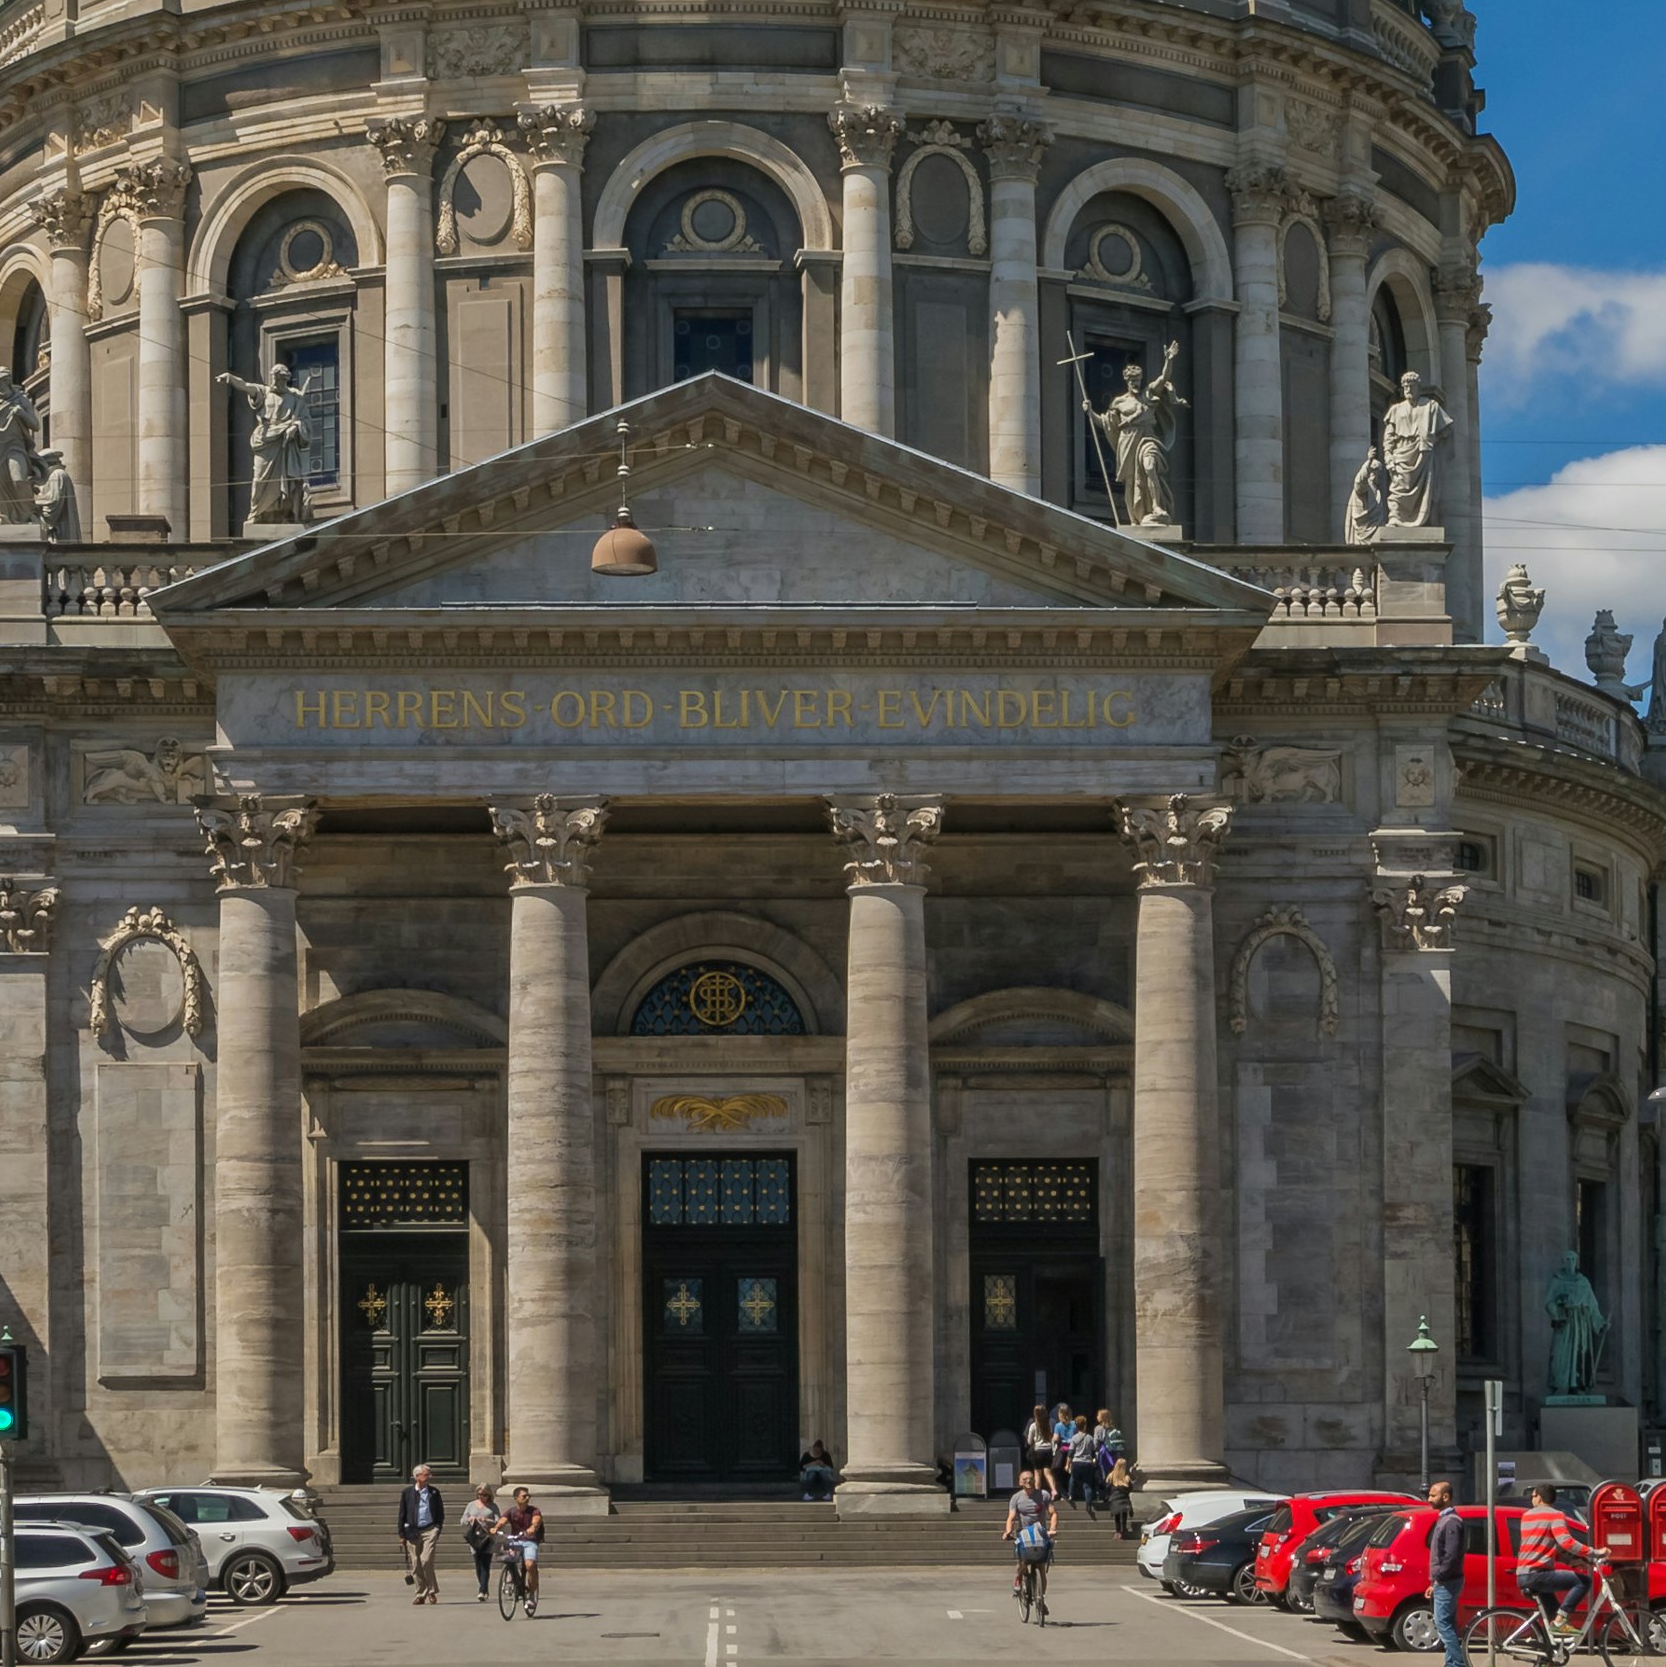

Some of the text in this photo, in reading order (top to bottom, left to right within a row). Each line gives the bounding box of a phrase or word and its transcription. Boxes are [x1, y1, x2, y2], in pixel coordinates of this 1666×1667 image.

[295, 690, 1137, 728] HERRENS ORD BLIVER EVINDELIG
